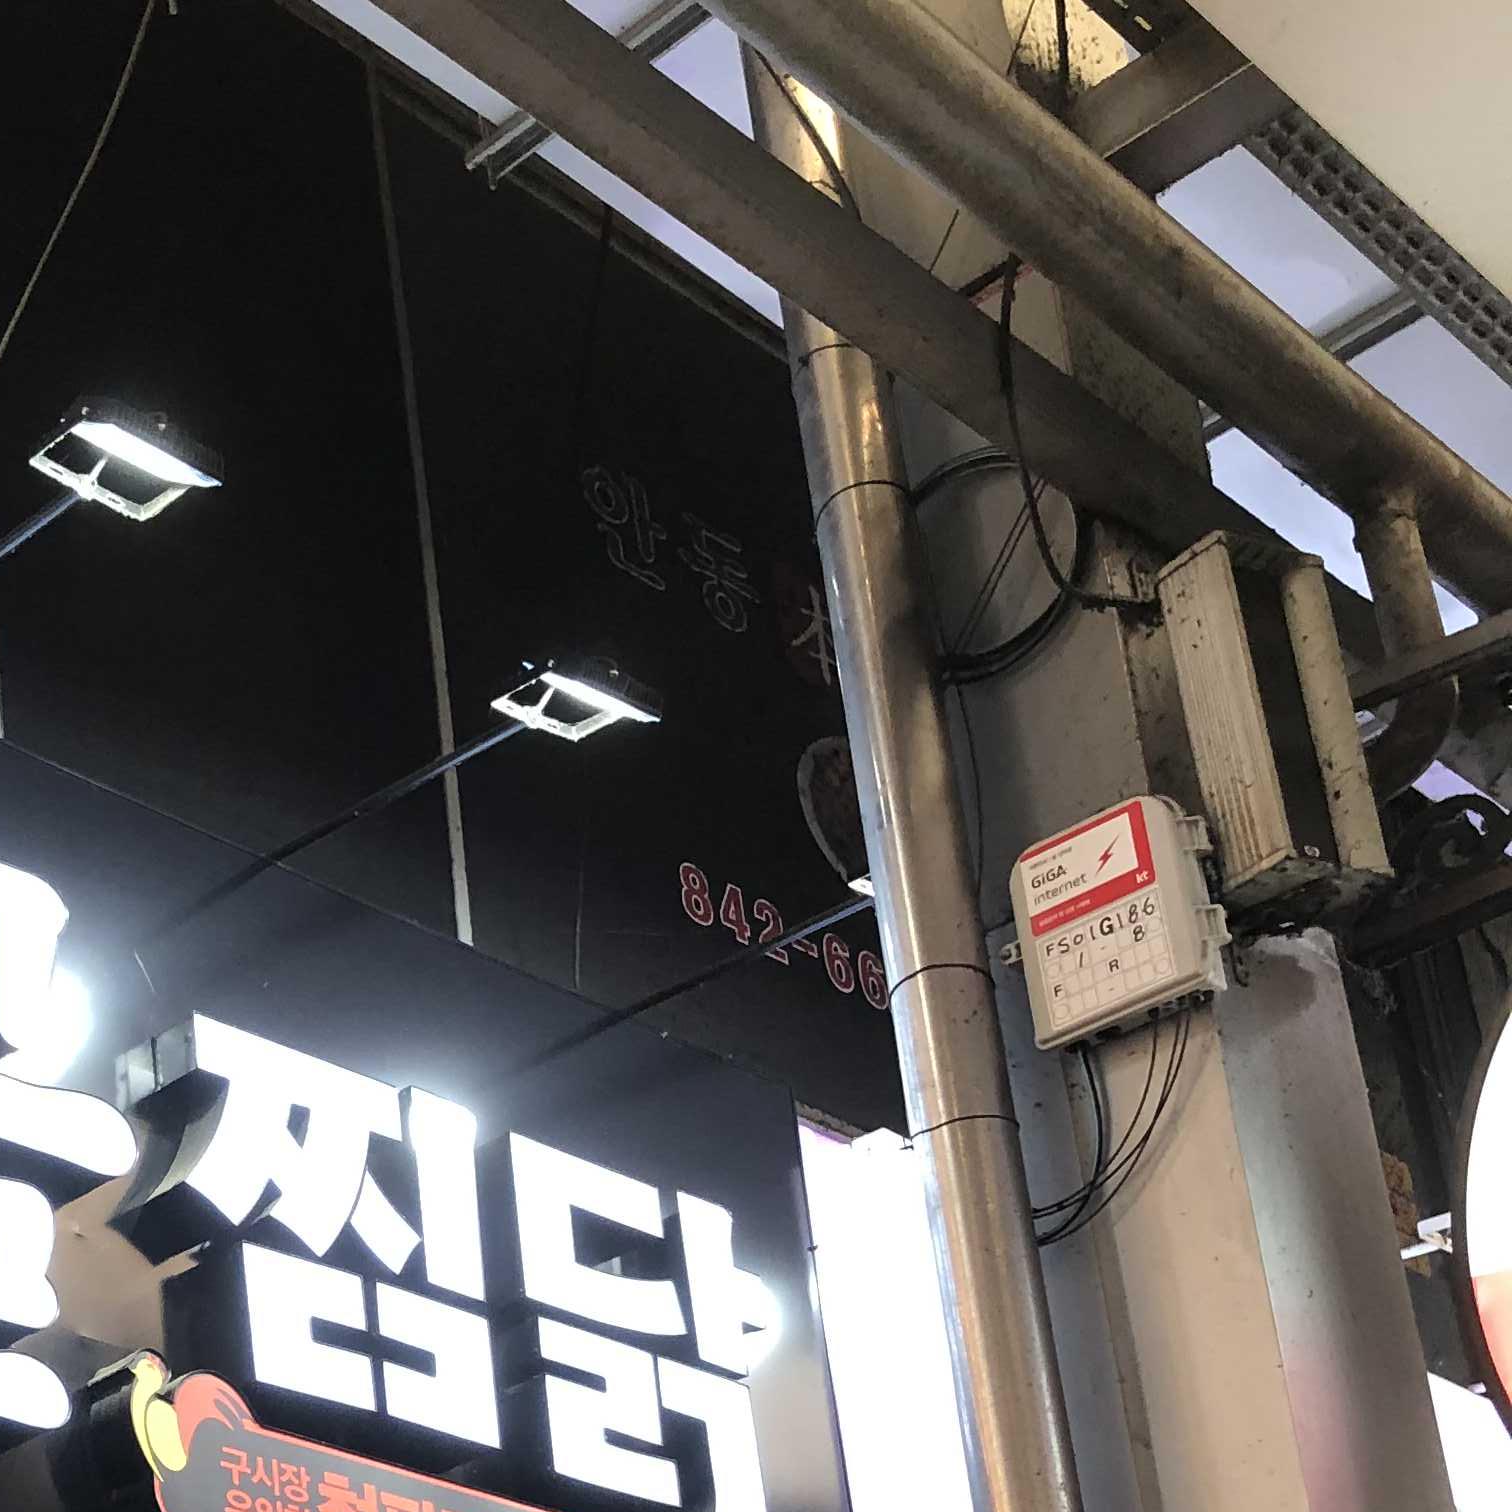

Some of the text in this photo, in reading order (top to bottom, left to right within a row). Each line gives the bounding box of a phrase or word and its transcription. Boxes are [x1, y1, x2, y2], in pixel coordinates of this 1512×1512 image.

[1033, 873, 1088, 906] internet
[1136, 870, 1149, 884] kt
[219, 1445, 310, 1502] 구시장
